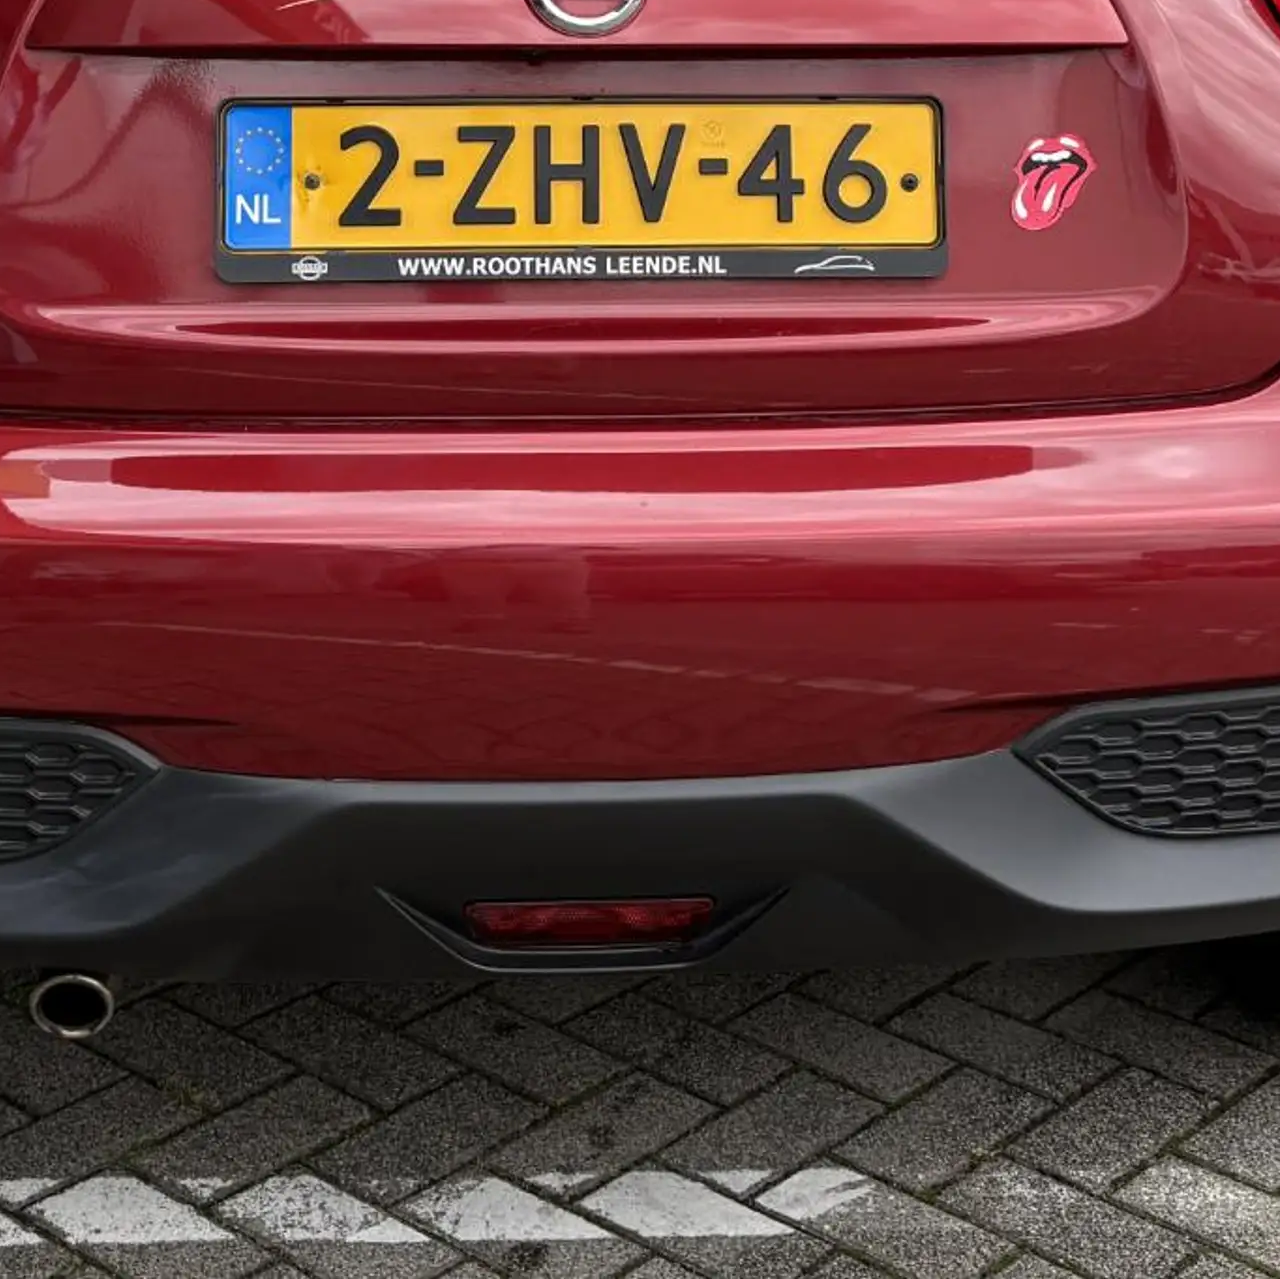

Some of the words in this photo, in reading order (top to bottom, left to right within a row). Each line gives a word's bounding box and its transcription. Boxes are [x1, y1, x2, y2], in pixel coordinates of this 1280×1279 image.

[337, 123, 888, 227] 2-ZHV-46
[235, 193, 282, 224] NL
[397, 256, 597, 277] WWW.ROOTHANS
[605, 256, 727, 276] LEENDE.NL
